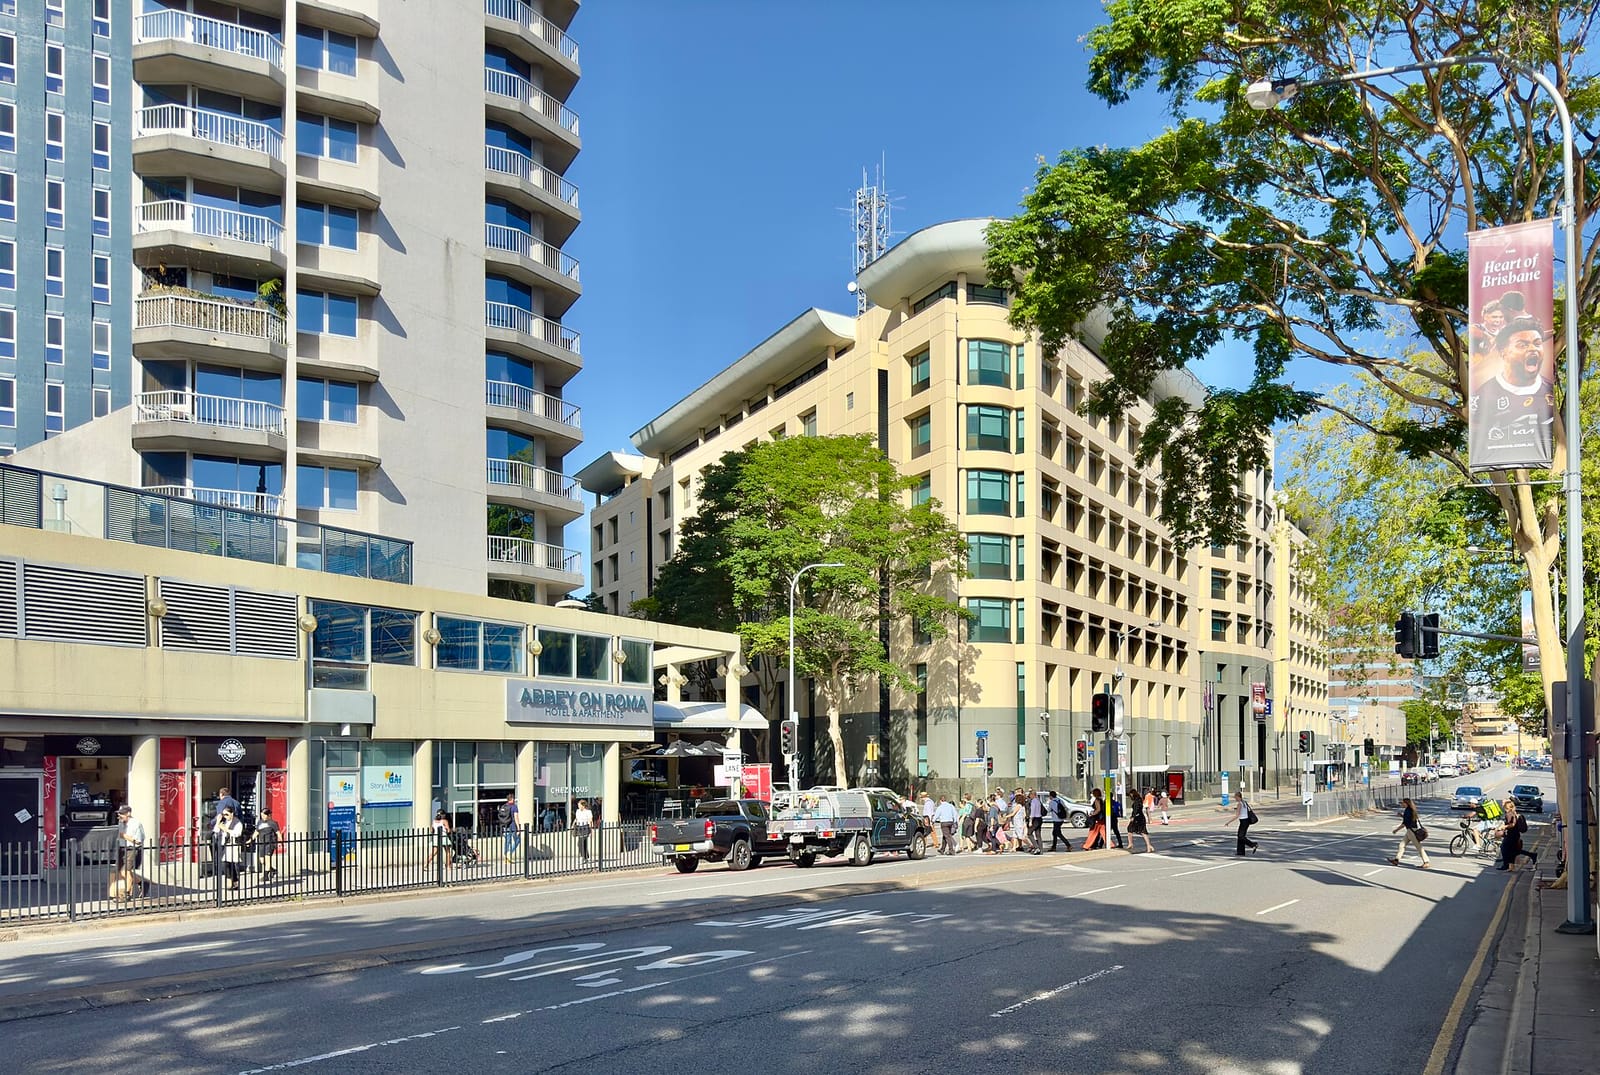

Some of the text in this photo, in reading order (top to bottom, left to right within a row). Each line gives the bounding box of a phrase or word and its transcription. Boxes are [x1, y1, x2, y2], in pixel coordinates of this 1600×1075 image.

[1484, 253, 1540, 274] Heart of
[1481, 269, 1541, 288] Brisbane
[520, 687, 648, 713] ABBEY ON ROMA
[545, 708, 570, 717] HOTEL
[578, 709, 625, 719] APARTMENTS
[725, 764, 740, 772] LANE
[550, 786, 569, 794] CHEZ
